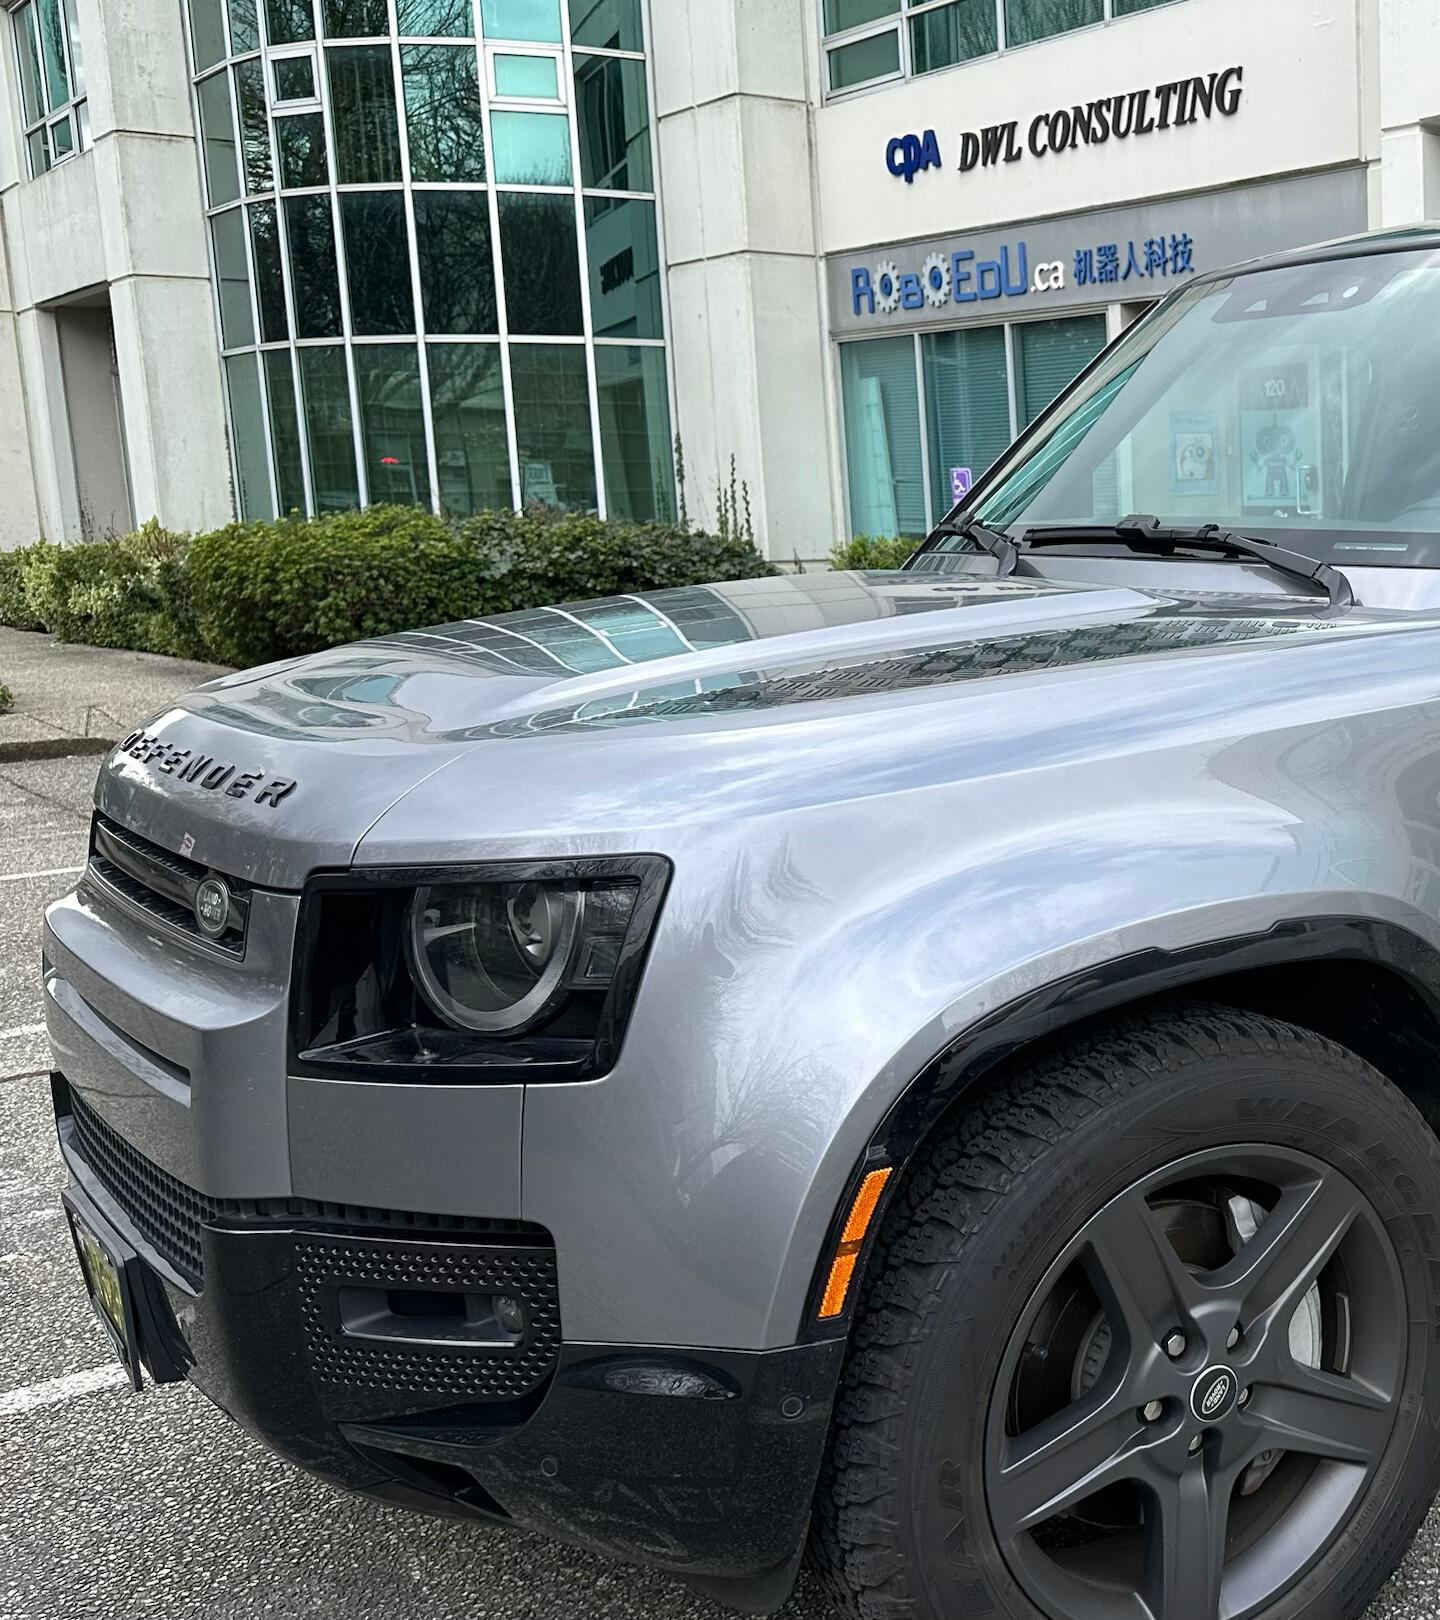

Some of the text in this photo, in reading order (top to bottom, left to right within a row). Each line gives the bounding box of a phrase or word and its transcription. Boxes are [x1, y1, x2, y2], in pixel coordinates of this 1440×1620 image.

[958, 121, 1023, 172] DWL
[1028, 66, 1243, 157] CONSULTING
[1073, 232, 1196, 286] 机器人科技
[1264, 379, 1285, 397] 120
[119, 728, 298, 808] DEFENDER
